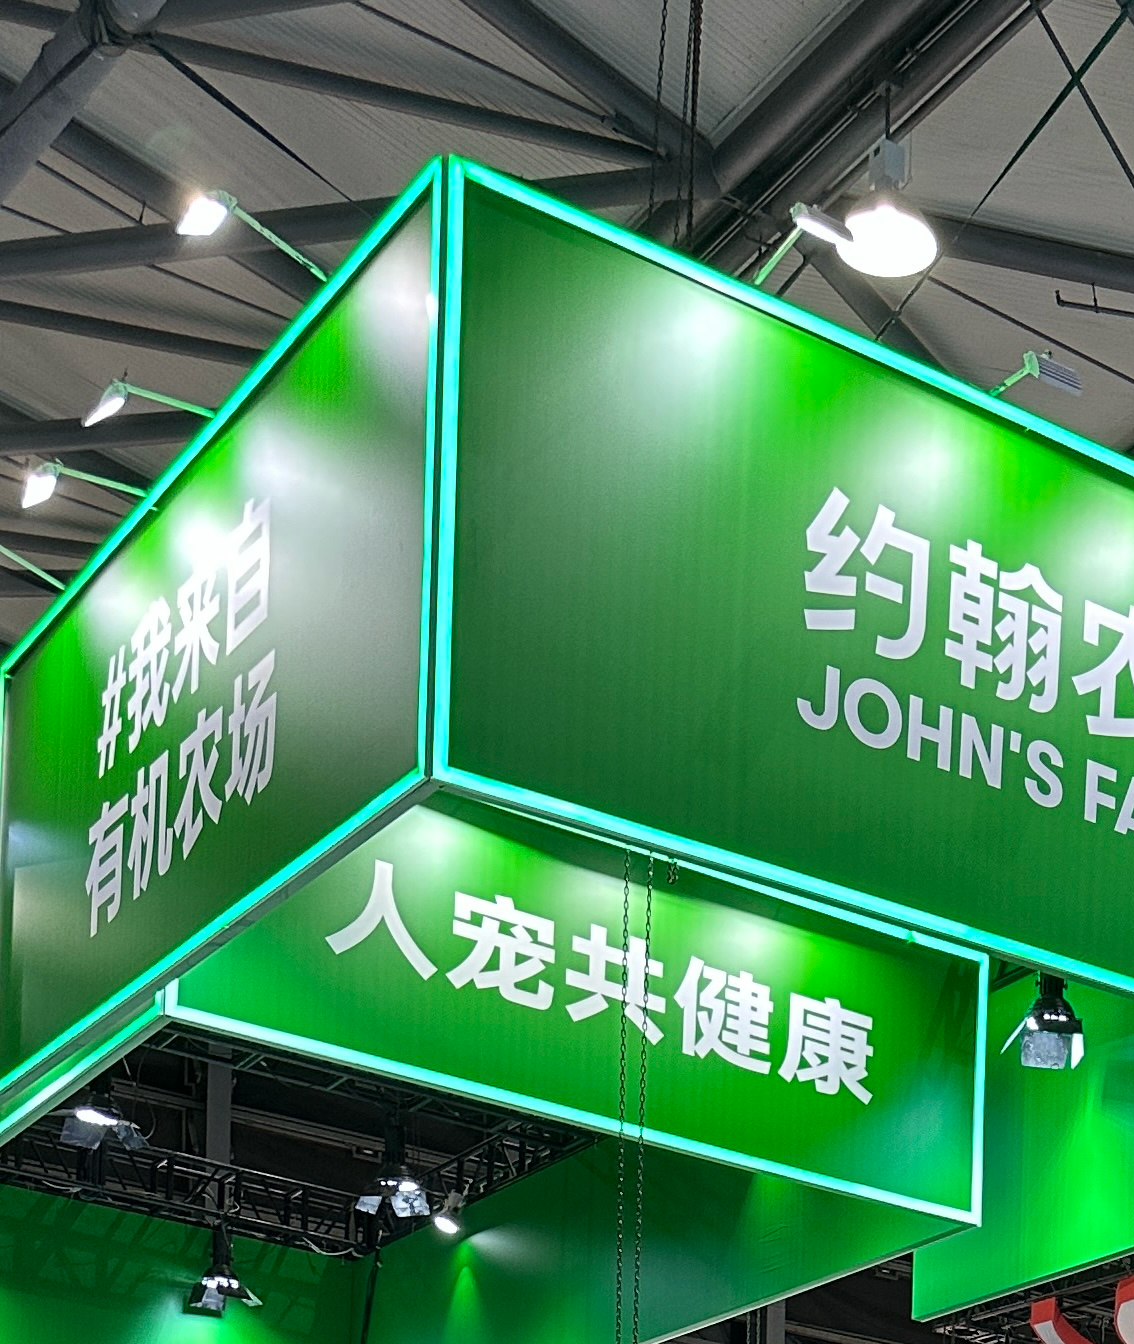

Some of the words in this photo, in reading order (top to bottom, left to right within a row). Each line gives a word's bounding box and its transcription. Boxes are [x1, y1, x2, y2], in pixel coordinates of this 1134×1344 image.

[97, 497, 272, 778] #我来自
[796, 665, 1064, 808] JOHN'S
[84, 649, 277, 937] 有机农场
[325, 859, 874, 1105] 人宠共健康
